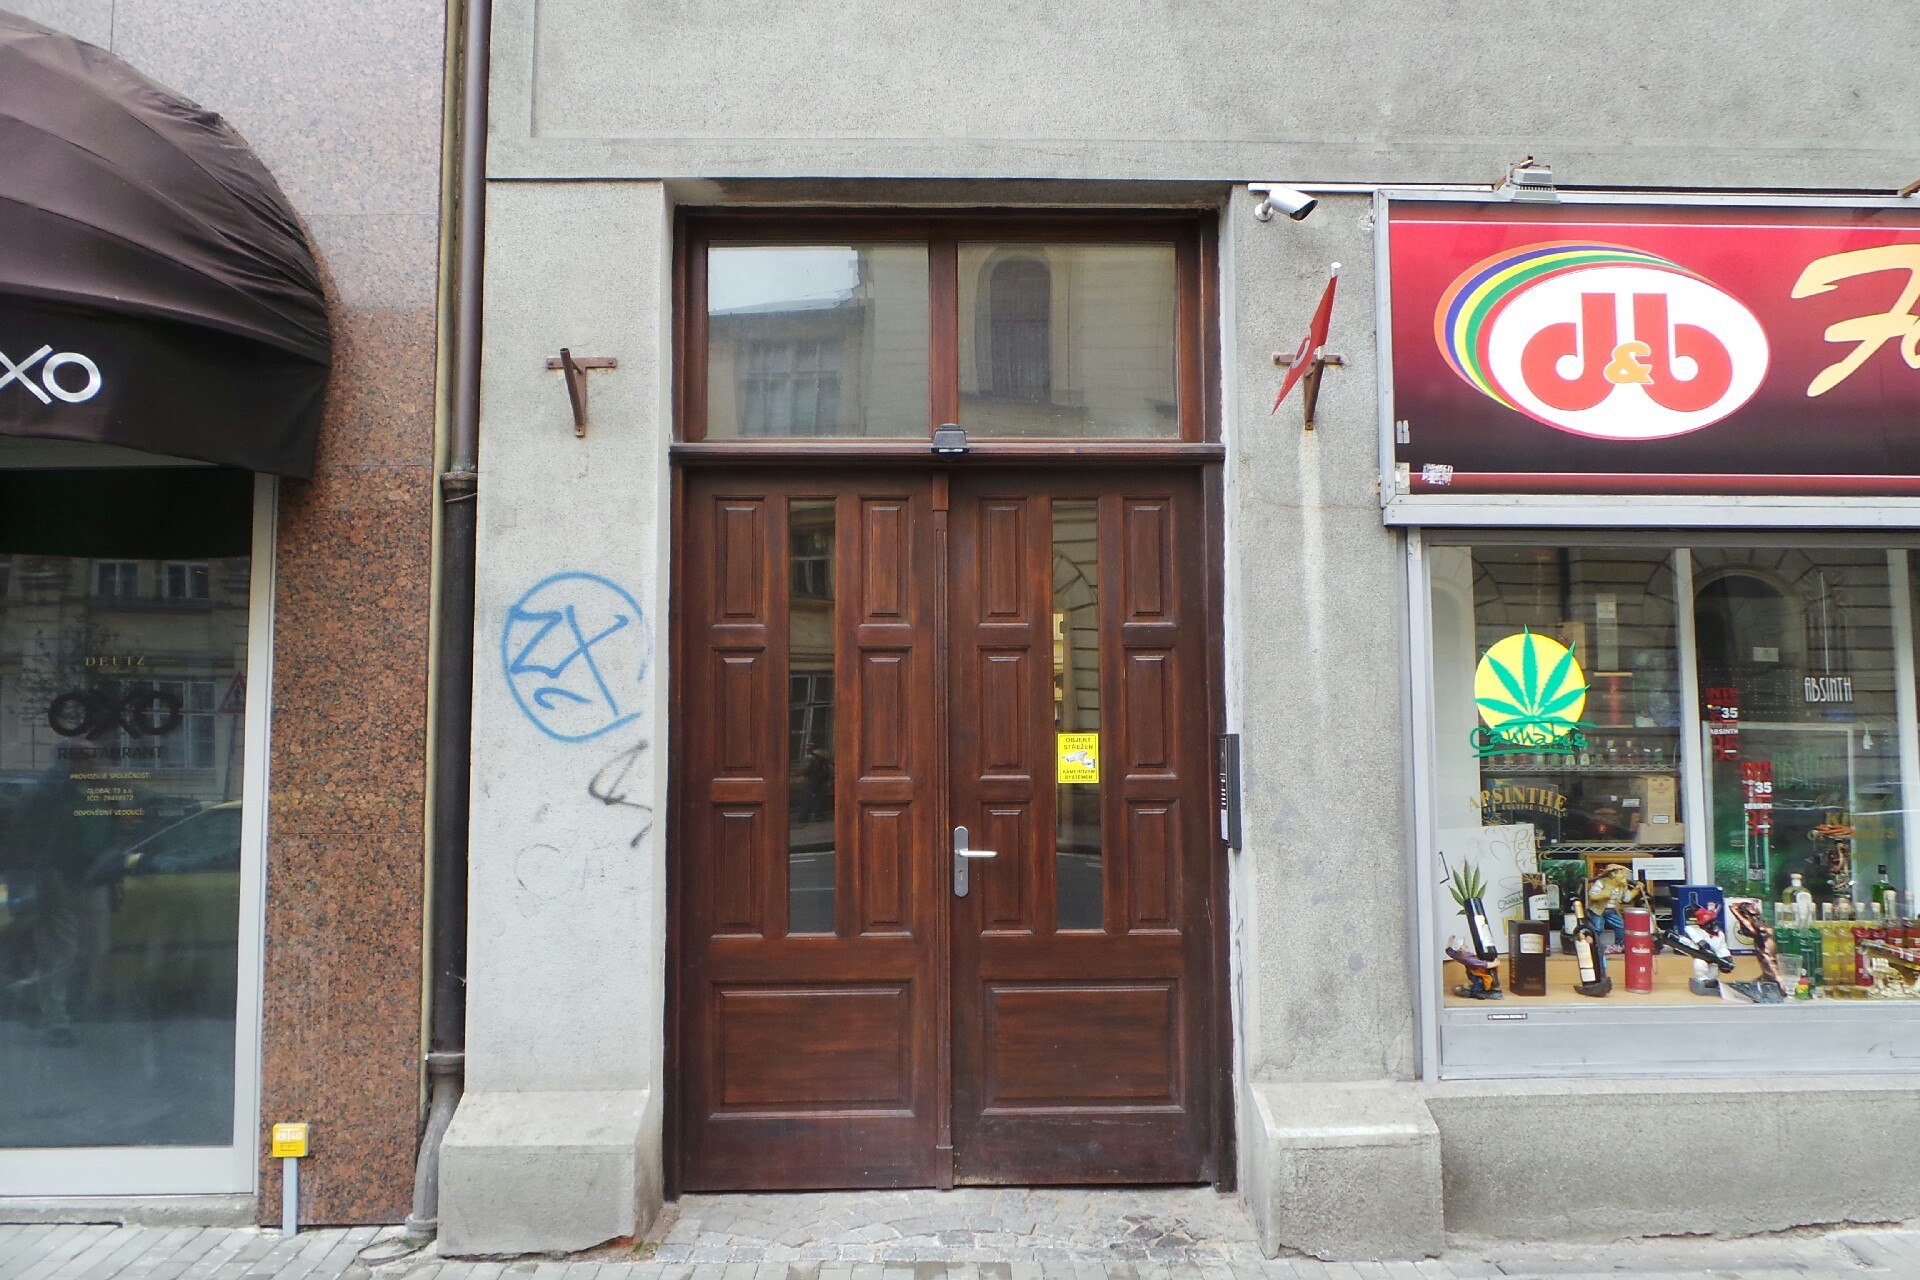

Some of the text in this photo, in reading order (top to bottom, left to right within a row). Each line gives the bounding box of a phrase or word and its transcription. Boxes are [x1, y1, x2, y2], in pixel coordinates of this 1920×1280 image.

[1790, 243, 1920, 398] F
[1520, 292, 1733, 413] d&b
[85, 655, 145, 667] DEUTZ
[1803, 677, 1854, 703] ABSINTH
[1721, 707, 1739, 719] 35
[1754, 780, 1773, 794] 35
